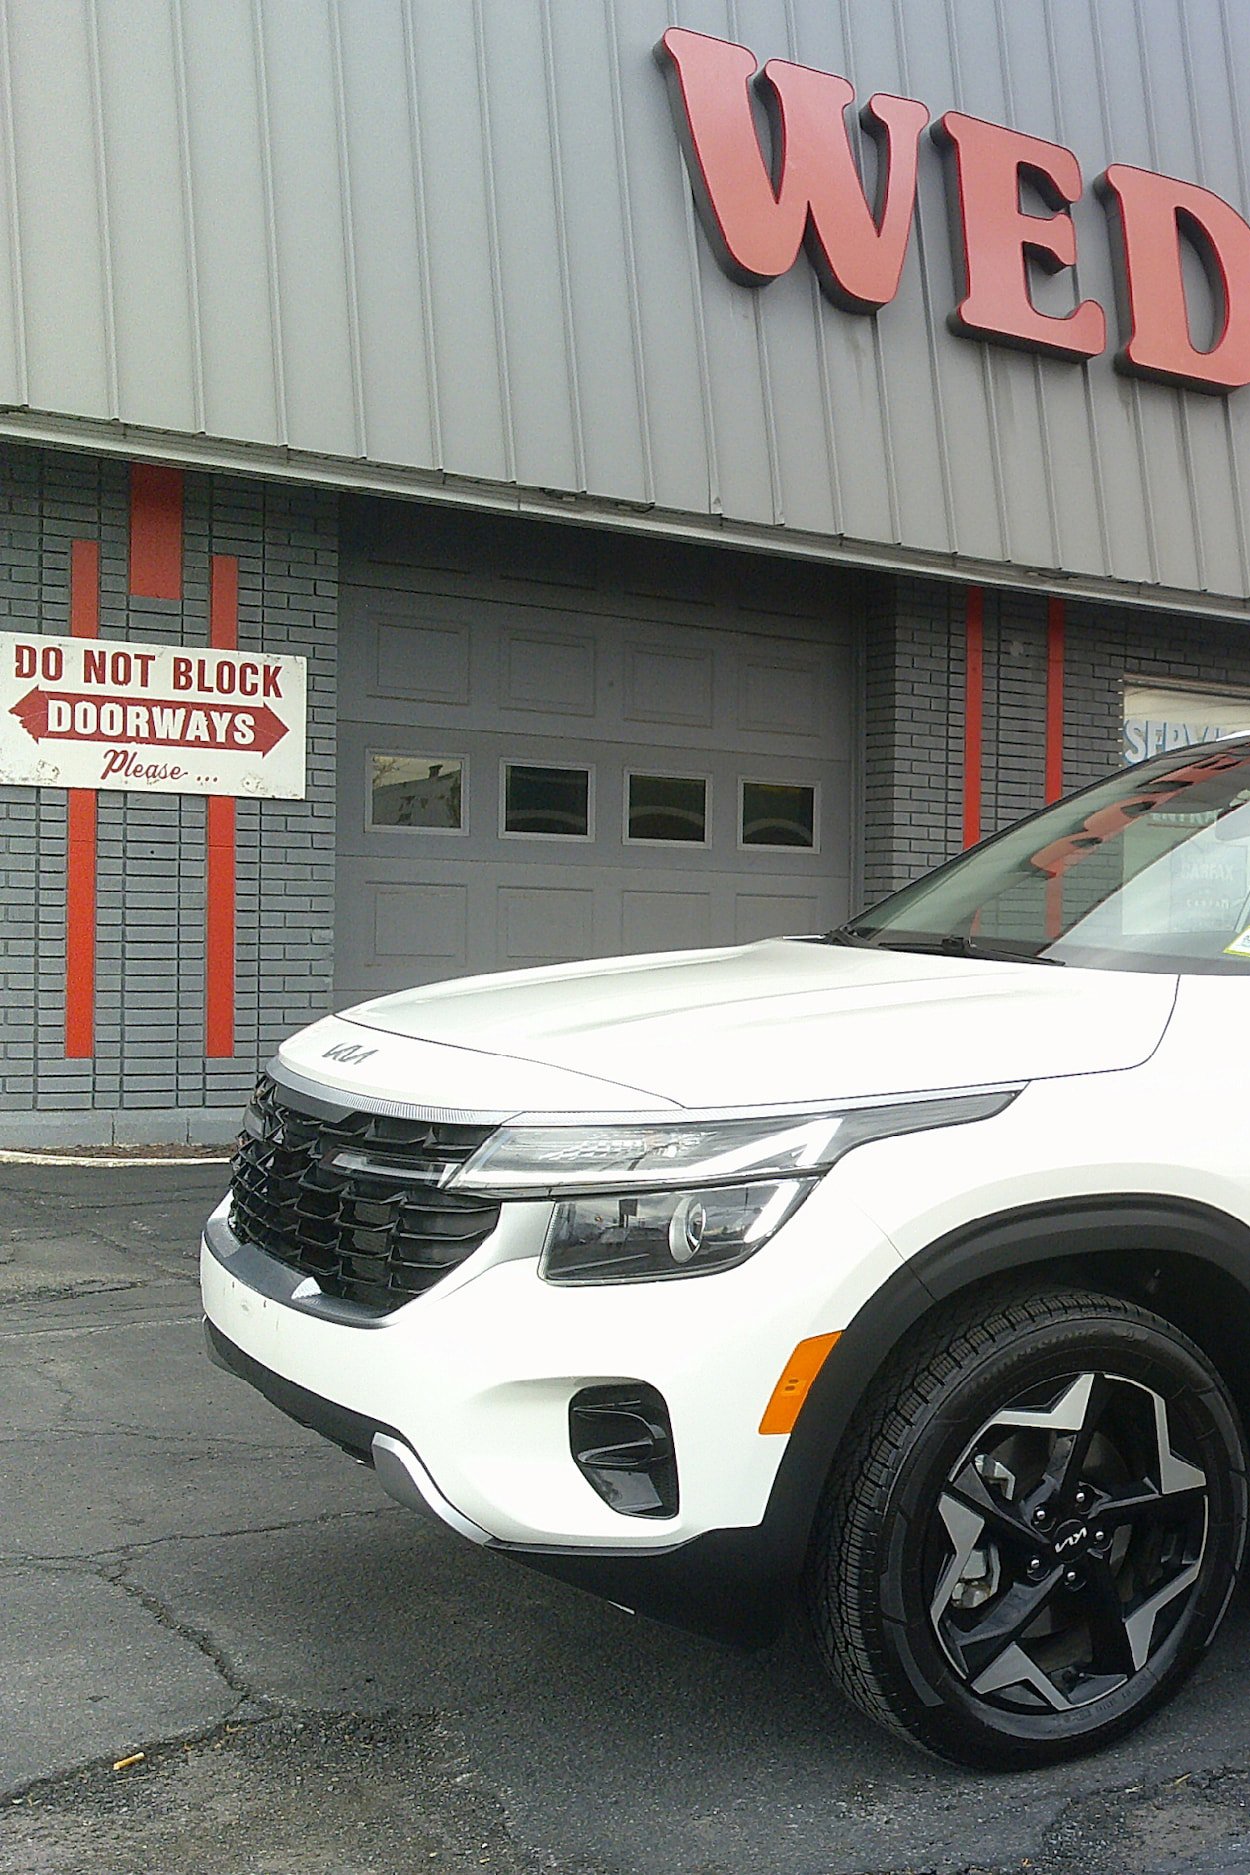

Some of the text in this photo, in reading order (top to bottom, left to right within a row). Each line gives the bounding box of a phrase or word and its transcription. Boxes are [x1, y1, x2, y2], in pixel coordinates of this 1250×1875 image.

[15, 644, 282, 698] DO NOT BLOCK
[48, 699, 255, 745] DOORWAYS
[321, 1042, 379, 1065] KIA
[1054, 1526, 1088, 1554] KIA
